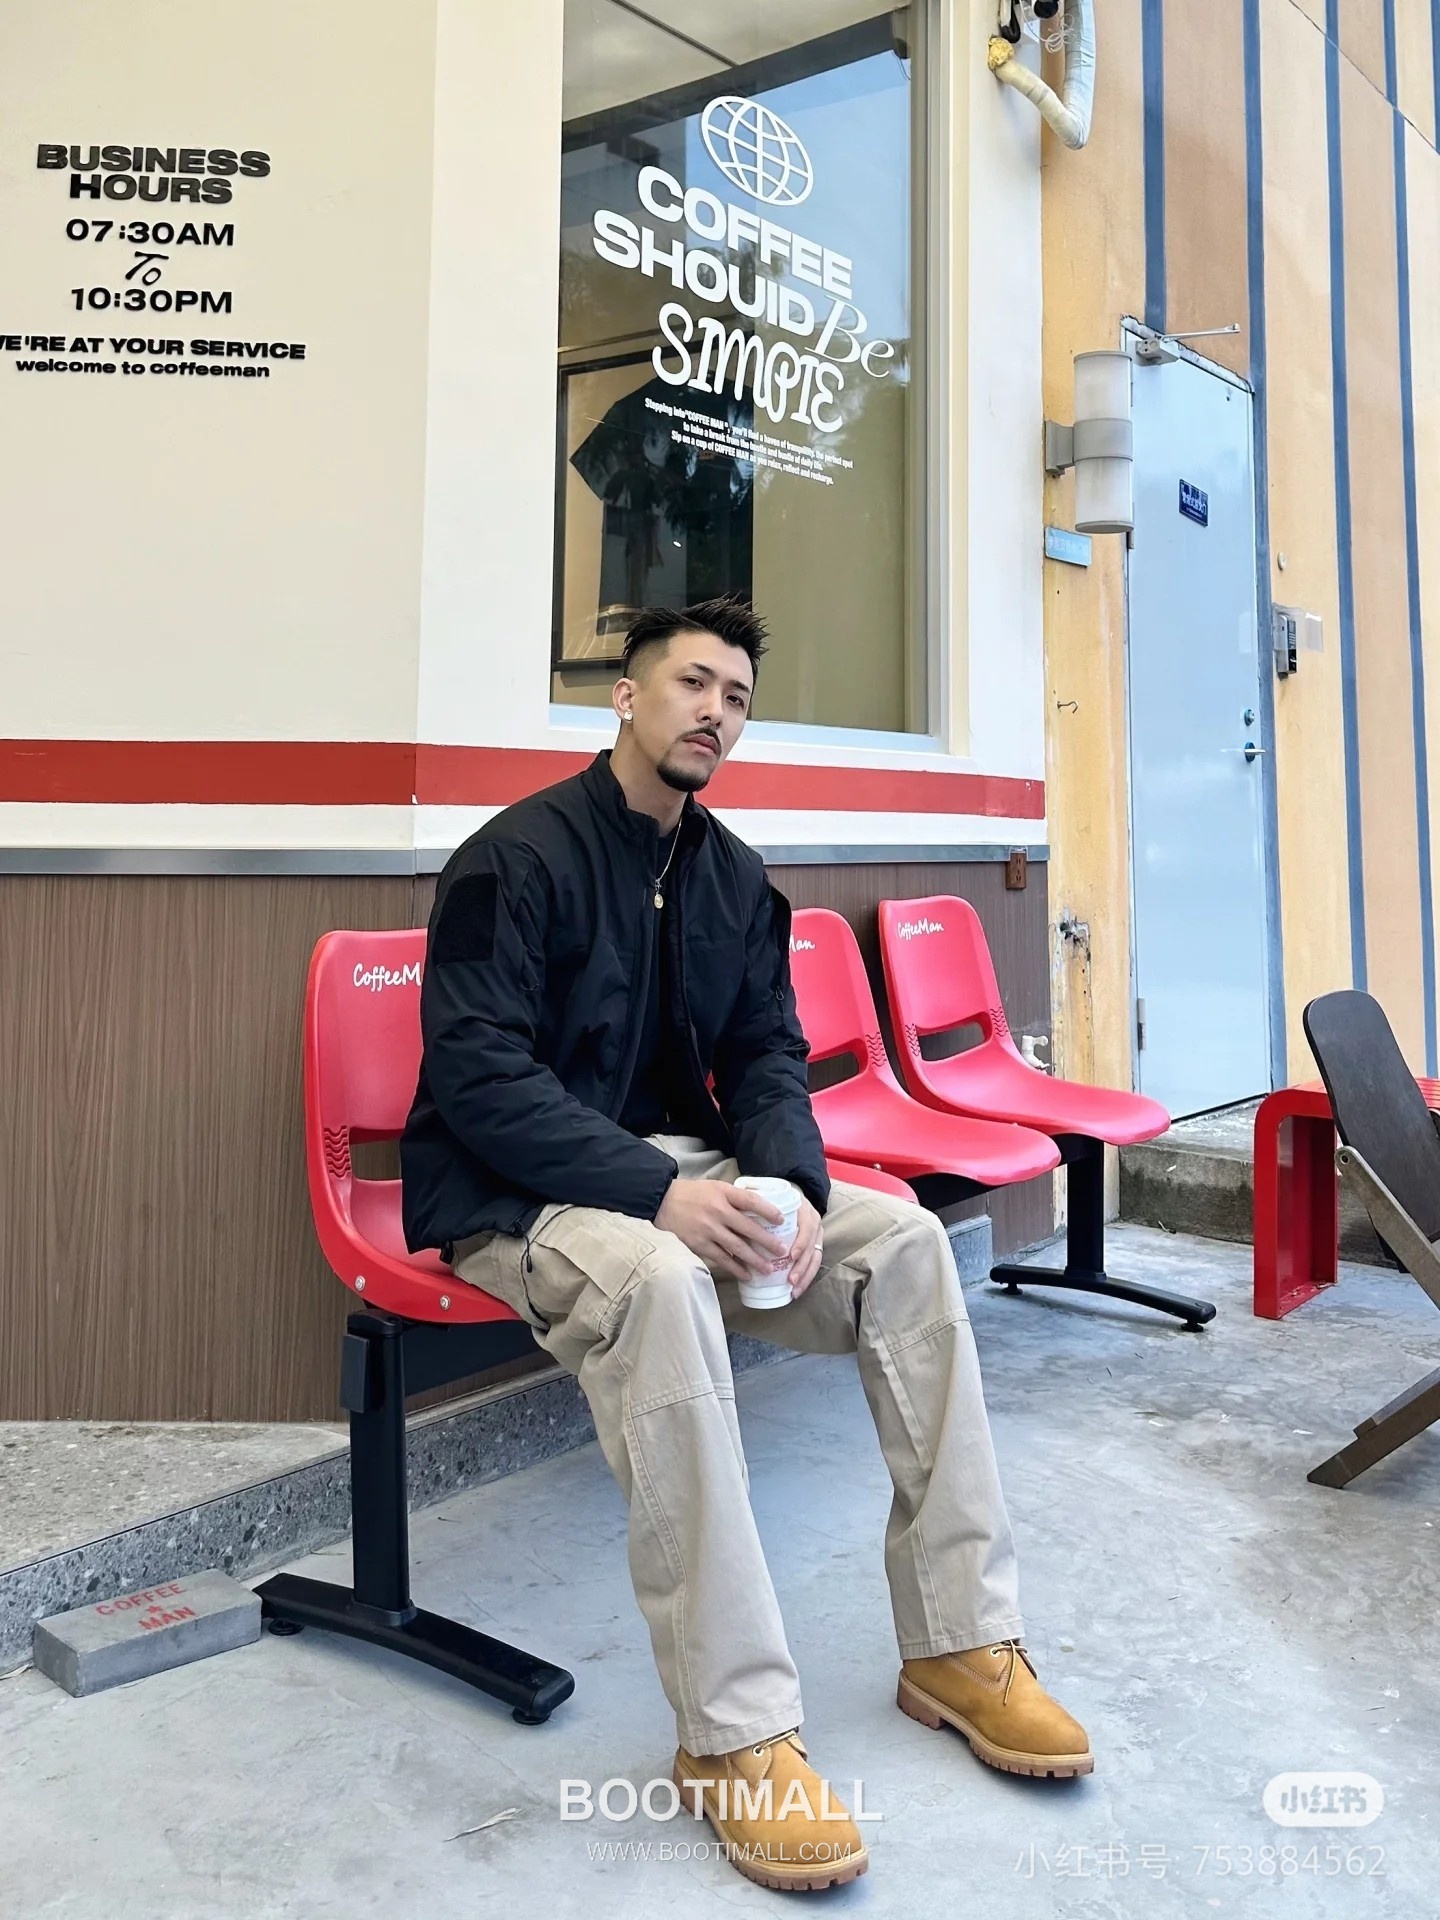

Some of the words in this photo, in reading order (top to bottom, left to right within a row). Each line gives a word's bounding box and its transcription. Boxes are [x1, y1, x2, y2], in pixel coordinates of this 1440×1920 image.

[36, 143, 271, 178] BUSINESS
[69, 173, 233, 204] HOURS
[66, 218, 234, 246] 07:30AM
[637, 165, 852, 300] COFFEE
[124, 250, 169, 286] To
[71, 287, 232, 314] 10:30PM
[69, 337, 104, 353] AT
[109, 337, 184, 356] YOUR
[190, 338, 306, 360] SERVICE
[804, 294, 895, 379] Be
[15, 358, 117, 375] welcome
[121, 360, 145, 375] to
[149, 360, 270, 378] coffeeman
[645, 397, 673, 417] Stepping
[897, 917, 945, 941] CoffeeMan
[353, 961, 422, 992] CoffeeM
[96, 1583, 188, 1616] COFFEE
[138, 1606, 197, 1631] MAN
